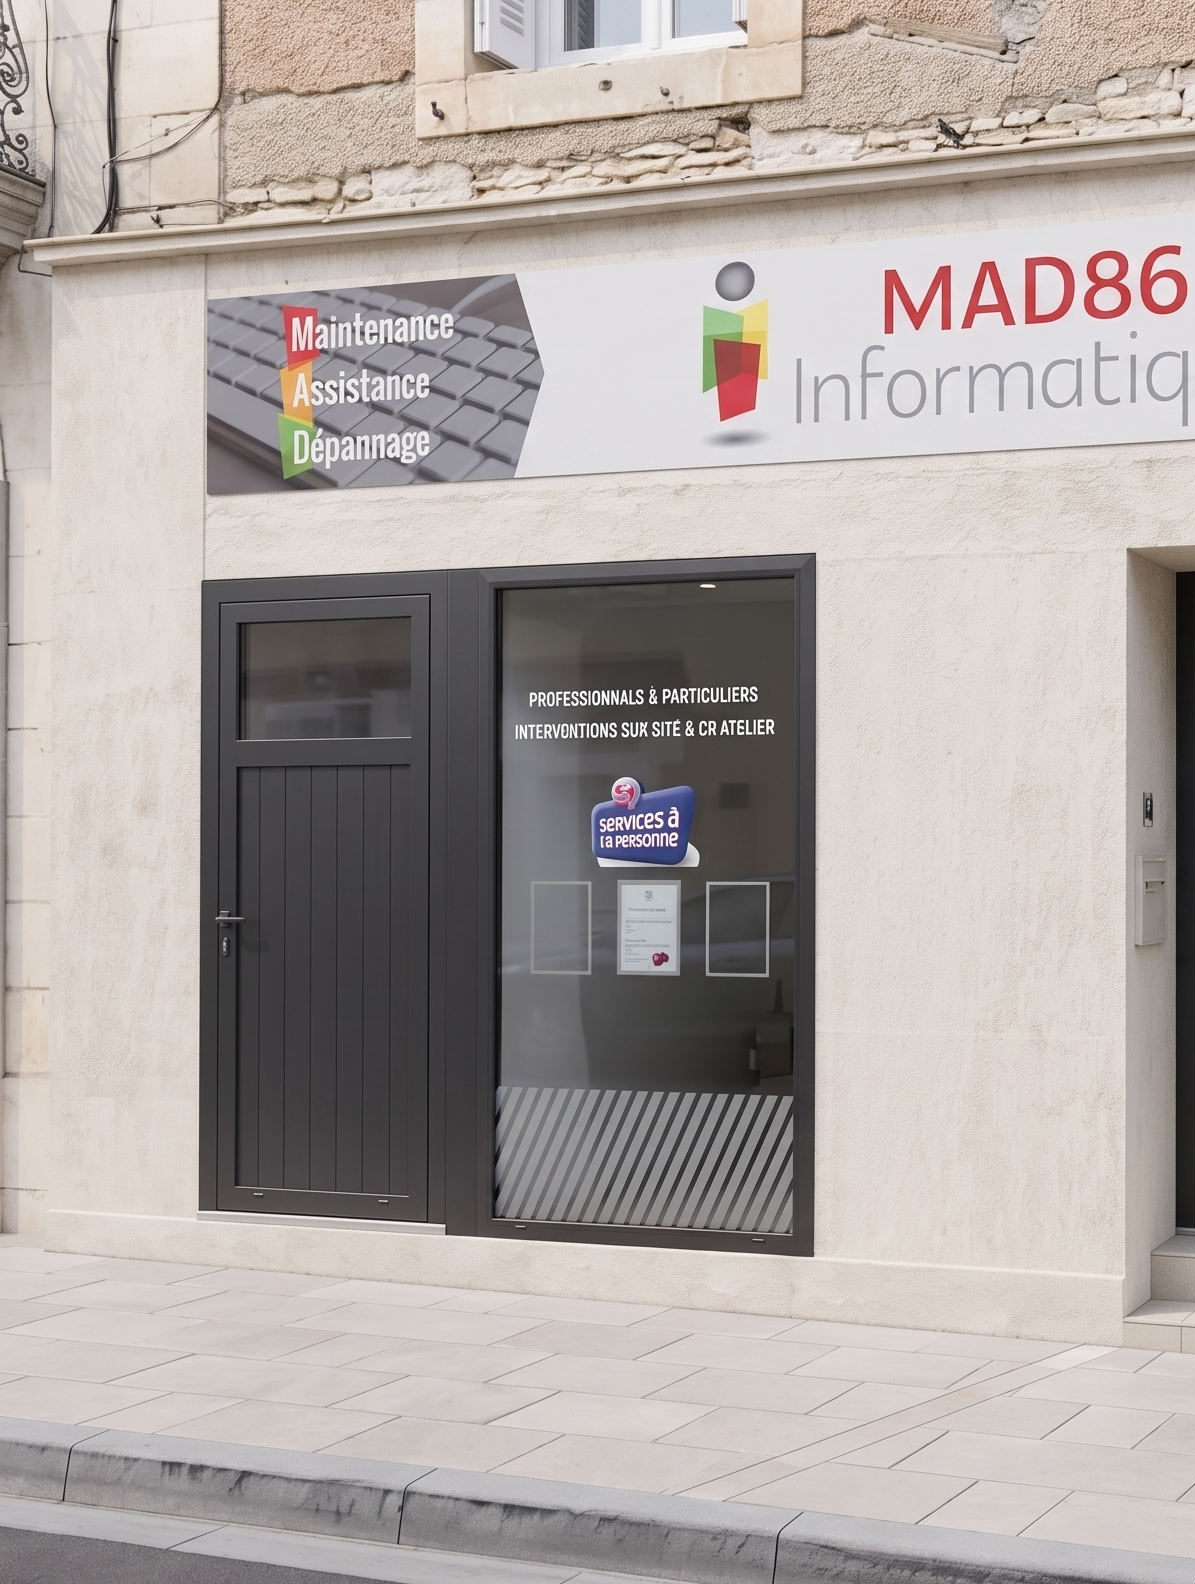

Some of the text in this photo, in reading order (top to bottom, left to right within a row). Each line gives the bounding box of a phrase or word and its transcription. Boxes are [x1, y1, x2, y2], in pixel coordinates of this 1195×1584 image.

[884, 244, 1188, 335] MAD86
[291, 310, 454, 353] Maintenance
[292, 370, 431, 409] Assistance
[293, 428, 430, 469] Dépannage
[529, 689, 644, 708] PROFESSIONNALS
[662, 686, 759, 705] PARTICULIERS
[652, 719, 681, 737] SITÉ
[685, 720, 695, 737] &
[698, 720, 717, 737] CR
[720, 719, 775, 737] ATELIER
